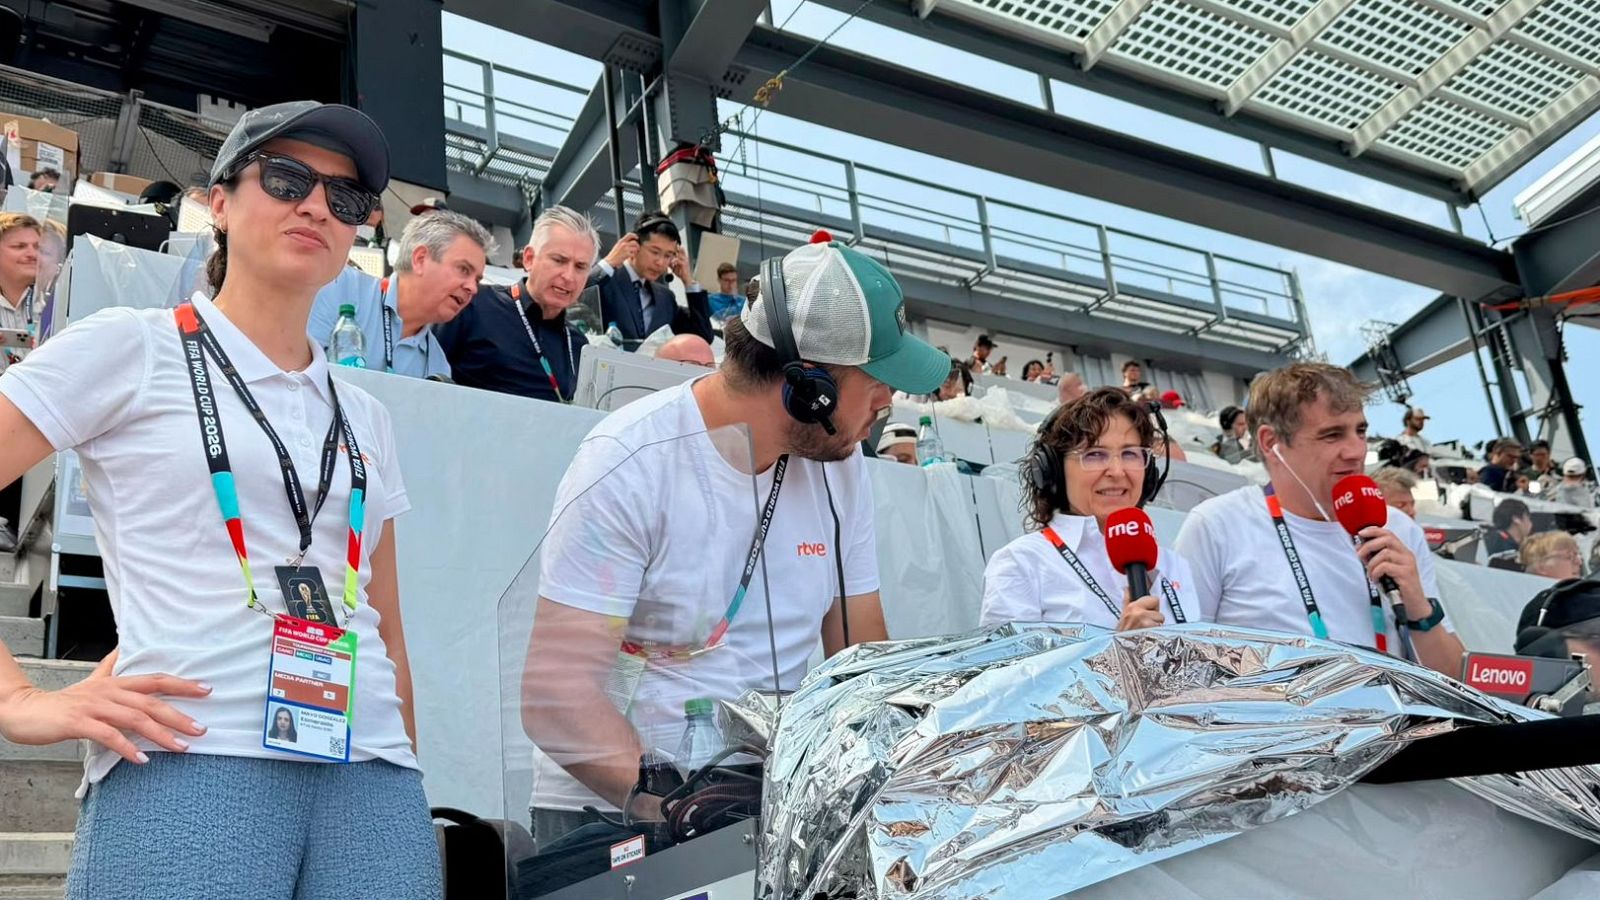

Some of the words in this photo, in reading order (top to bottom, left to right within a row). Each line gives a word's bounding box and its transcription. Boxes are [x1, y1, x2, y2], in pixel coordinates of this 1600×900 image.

[186, 340, 200, 362] FIFA
[192, 361, 208, 394] WORLD
[200, 394, 214, 418] CUP
[204, 416, 222, 456] 2026
[354, 460, 364, 480] FIFA
[776, 460, 786, 481] FIFA
[766, 483, 780, 518] WORLD
[1334, 491, 1354, 510] rne
[1108, 521, 1139, 538] rne
[746, 539, 760, 576] 2026
[797, 542, 826, 556] rtve
[1287, 548, 1298, 563] CUP
[1062, 549, 1078, 564] FIFA
[1073, 561, 1092, 584] WORLD
[1292, 562, 1308, 589] WORLD
[1302, 588, 1314, 606] FIFA
[1172, 605, 1184, 621] FIFA
[292, 630, 314, 640] WORLD
[274, 672, 294, 680] MEDIA
[296, 676, 324, 687] PARTNER
[1472, 662, 1526, 686] Lenovo
